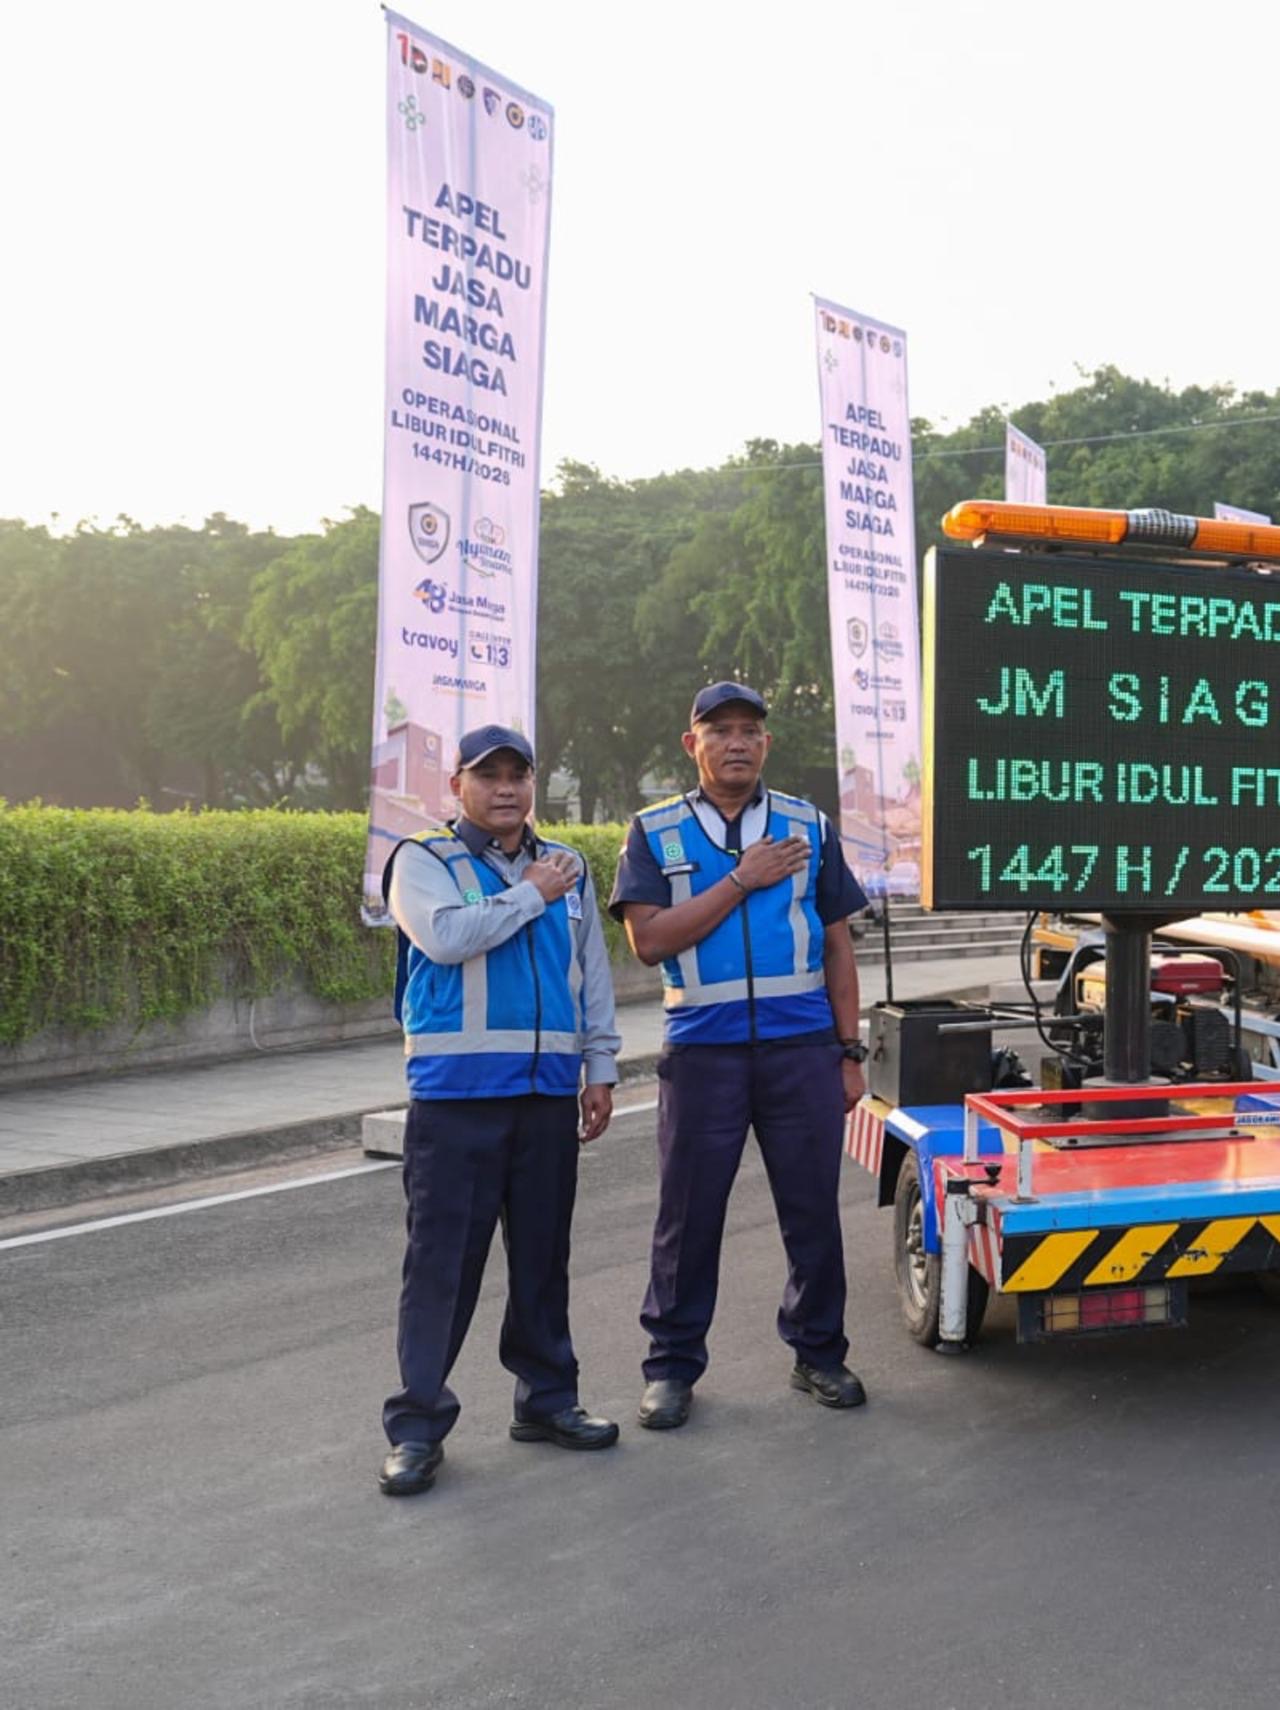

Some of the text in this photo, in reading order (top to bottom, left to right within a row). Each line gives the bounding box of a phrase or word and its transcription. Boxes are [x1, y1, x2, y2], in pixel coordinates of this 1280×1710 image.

[435, 182, 506, 239] APEL
[403, 204, 531, 290] TERPADU
[432, 264, 504, 318] JASA
[414, 294, 516, 362] MARGA
[423, 340, 507, 397] SIAGA
[391, 410, 447, 443] LIBUR
[488, 442, 526, 470] FITRI
[846, 401, 886, 431] APEL
[828, 423, 901, 461] TERPADU
[847, 457, 888, 484] JASA
[840, 480, 897, 512] MARGA
[845, 509, 895, 537] SIAGA
[985, 582, 1108, 630] APEL
[402, 627, 458, 659] travoy
[977, 667, 1065, 718] JM
[967, 758, 1104, 803] LIBUR
[1117, 762, 1218, 806] IDUL
[967, 843, 1099, 893] 1447
[1116, 845, 1152, 893] H
[1164, 845, 1190, 896] /
